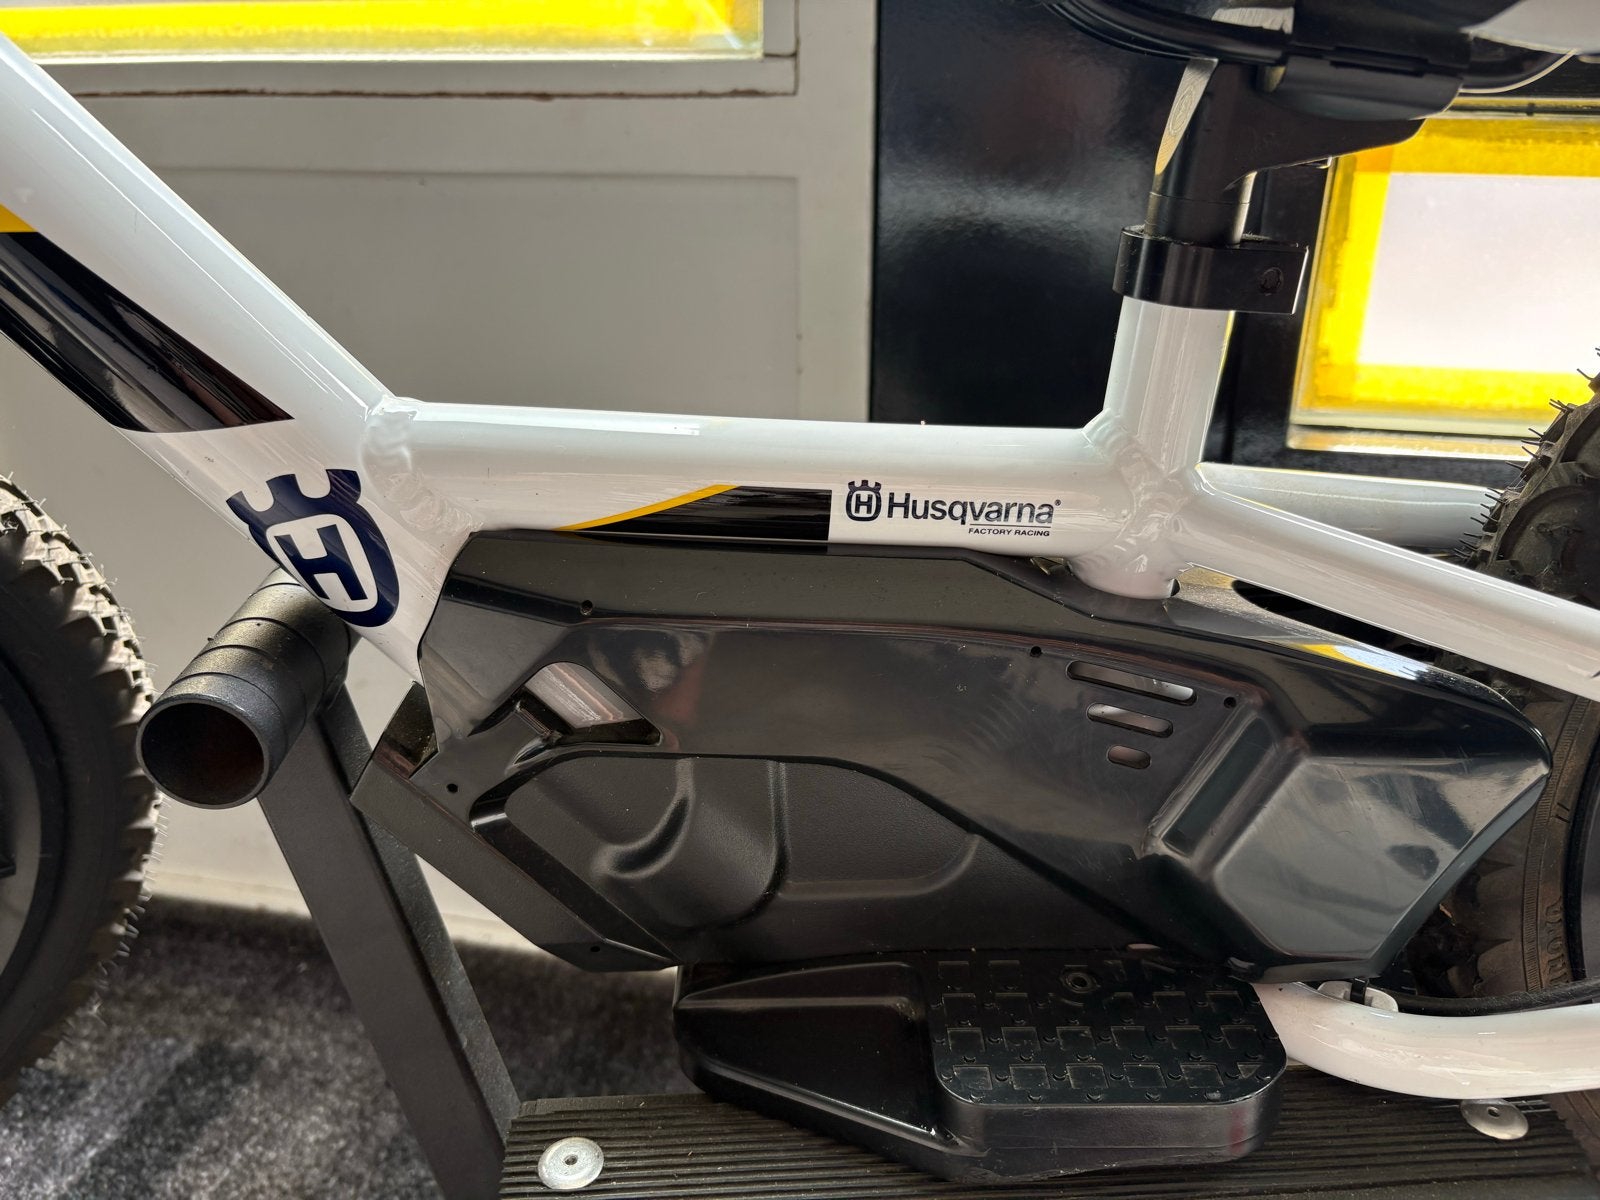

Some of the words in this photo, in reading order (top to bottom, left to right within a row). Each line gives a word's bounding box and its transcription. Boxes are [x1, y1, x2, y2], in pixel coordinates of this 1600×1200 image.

[854, 493, 874, 514] H
[968, 527, 1012, 536] FACTORY
[1014, 529, 1051, 537] RACING
[273, 523, 369, 601] H
